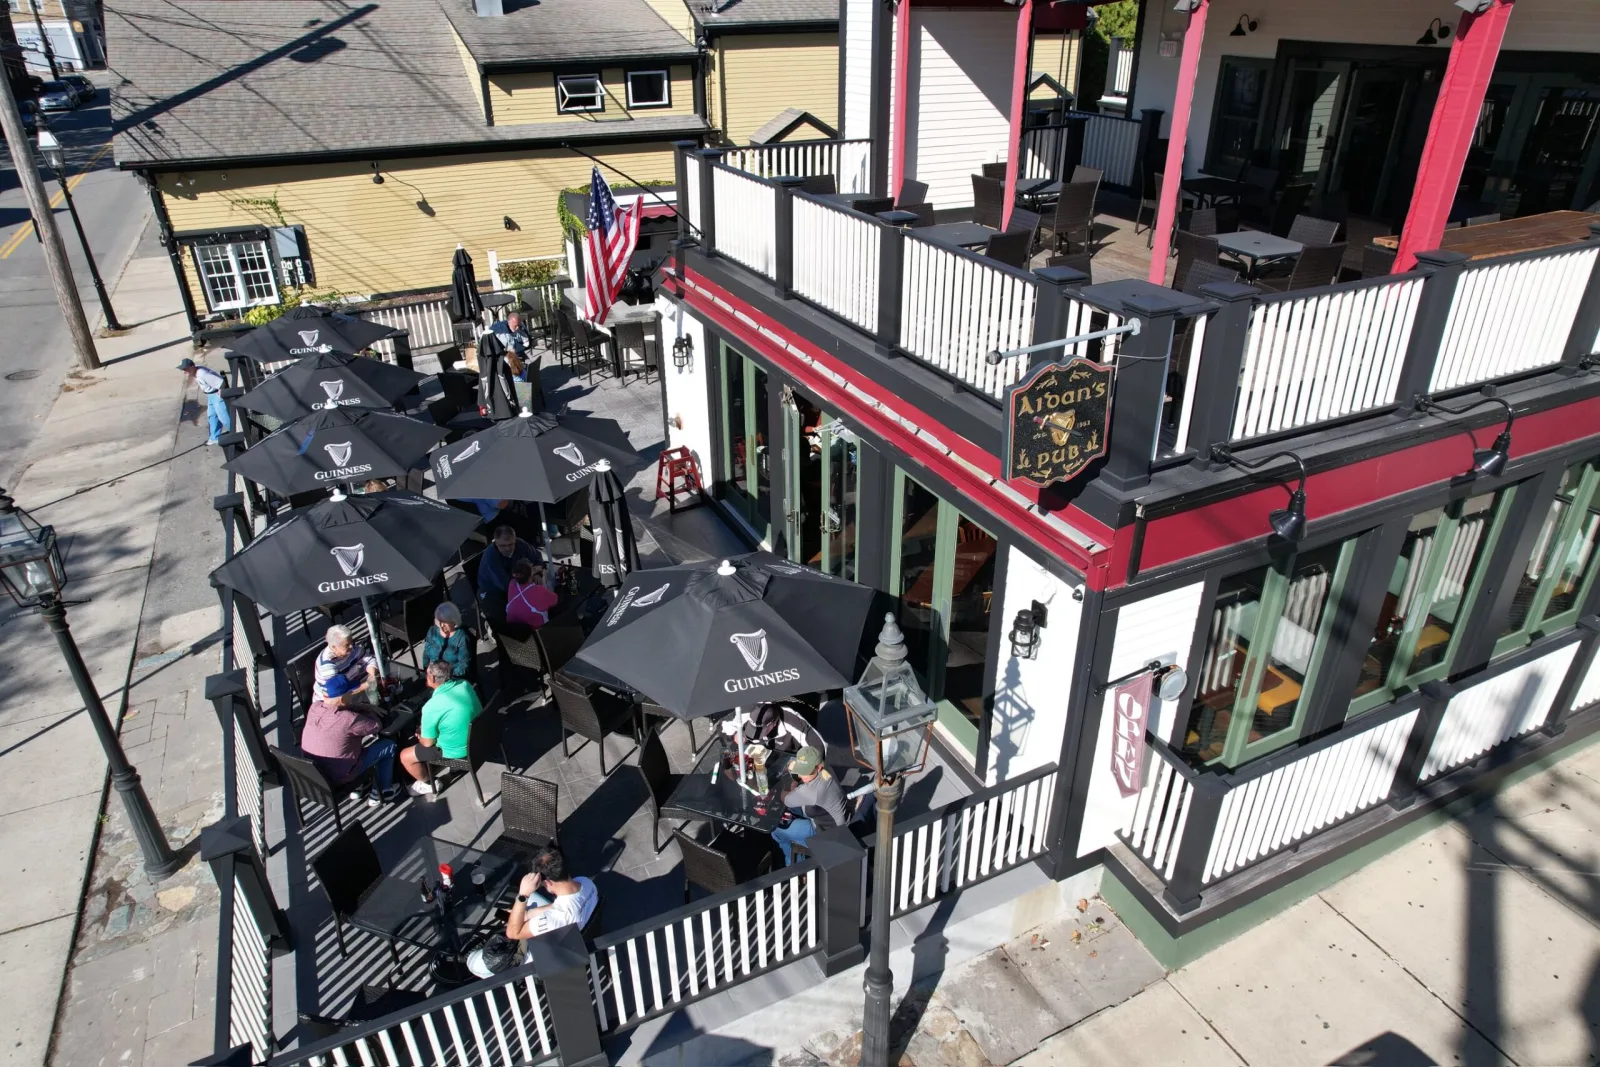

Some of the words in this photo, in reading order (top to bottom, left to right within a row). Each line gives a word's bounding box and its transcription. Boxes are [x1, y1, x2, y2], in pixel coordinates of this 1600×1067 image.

[314, 464, 372, 480] GUINNESS
[318, 572, 389, 593] GUINNESS
[724, 668, 800, 693] GUINNESS
[1115, 693, 1142, 788] OPEN
